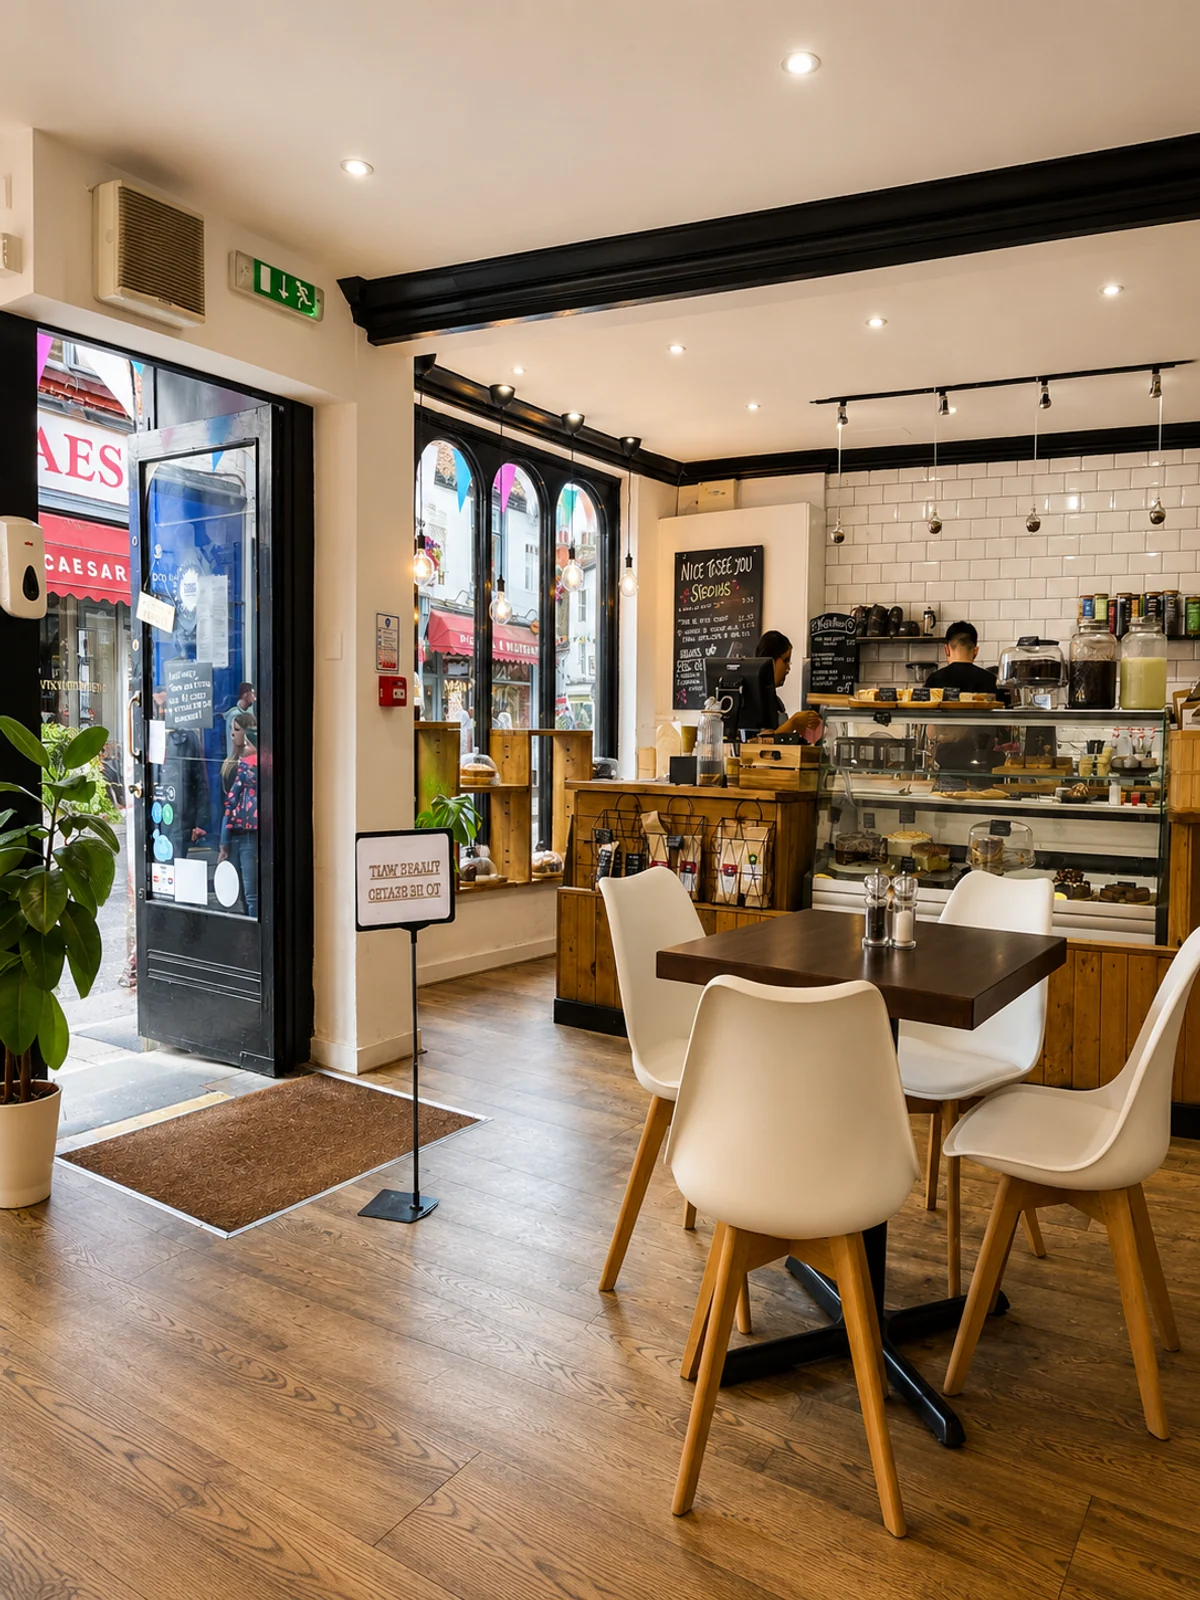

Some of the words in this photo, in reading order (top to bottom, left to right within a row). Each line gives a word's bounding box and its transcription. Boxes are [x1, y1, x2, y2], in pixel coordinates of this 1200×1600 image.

[37, 426, 123, 488] AES
[44, 553, 127, 582] CAESAR
[681, 562, 705, 581] NICE
[733, 555, 753, 576] YOU
